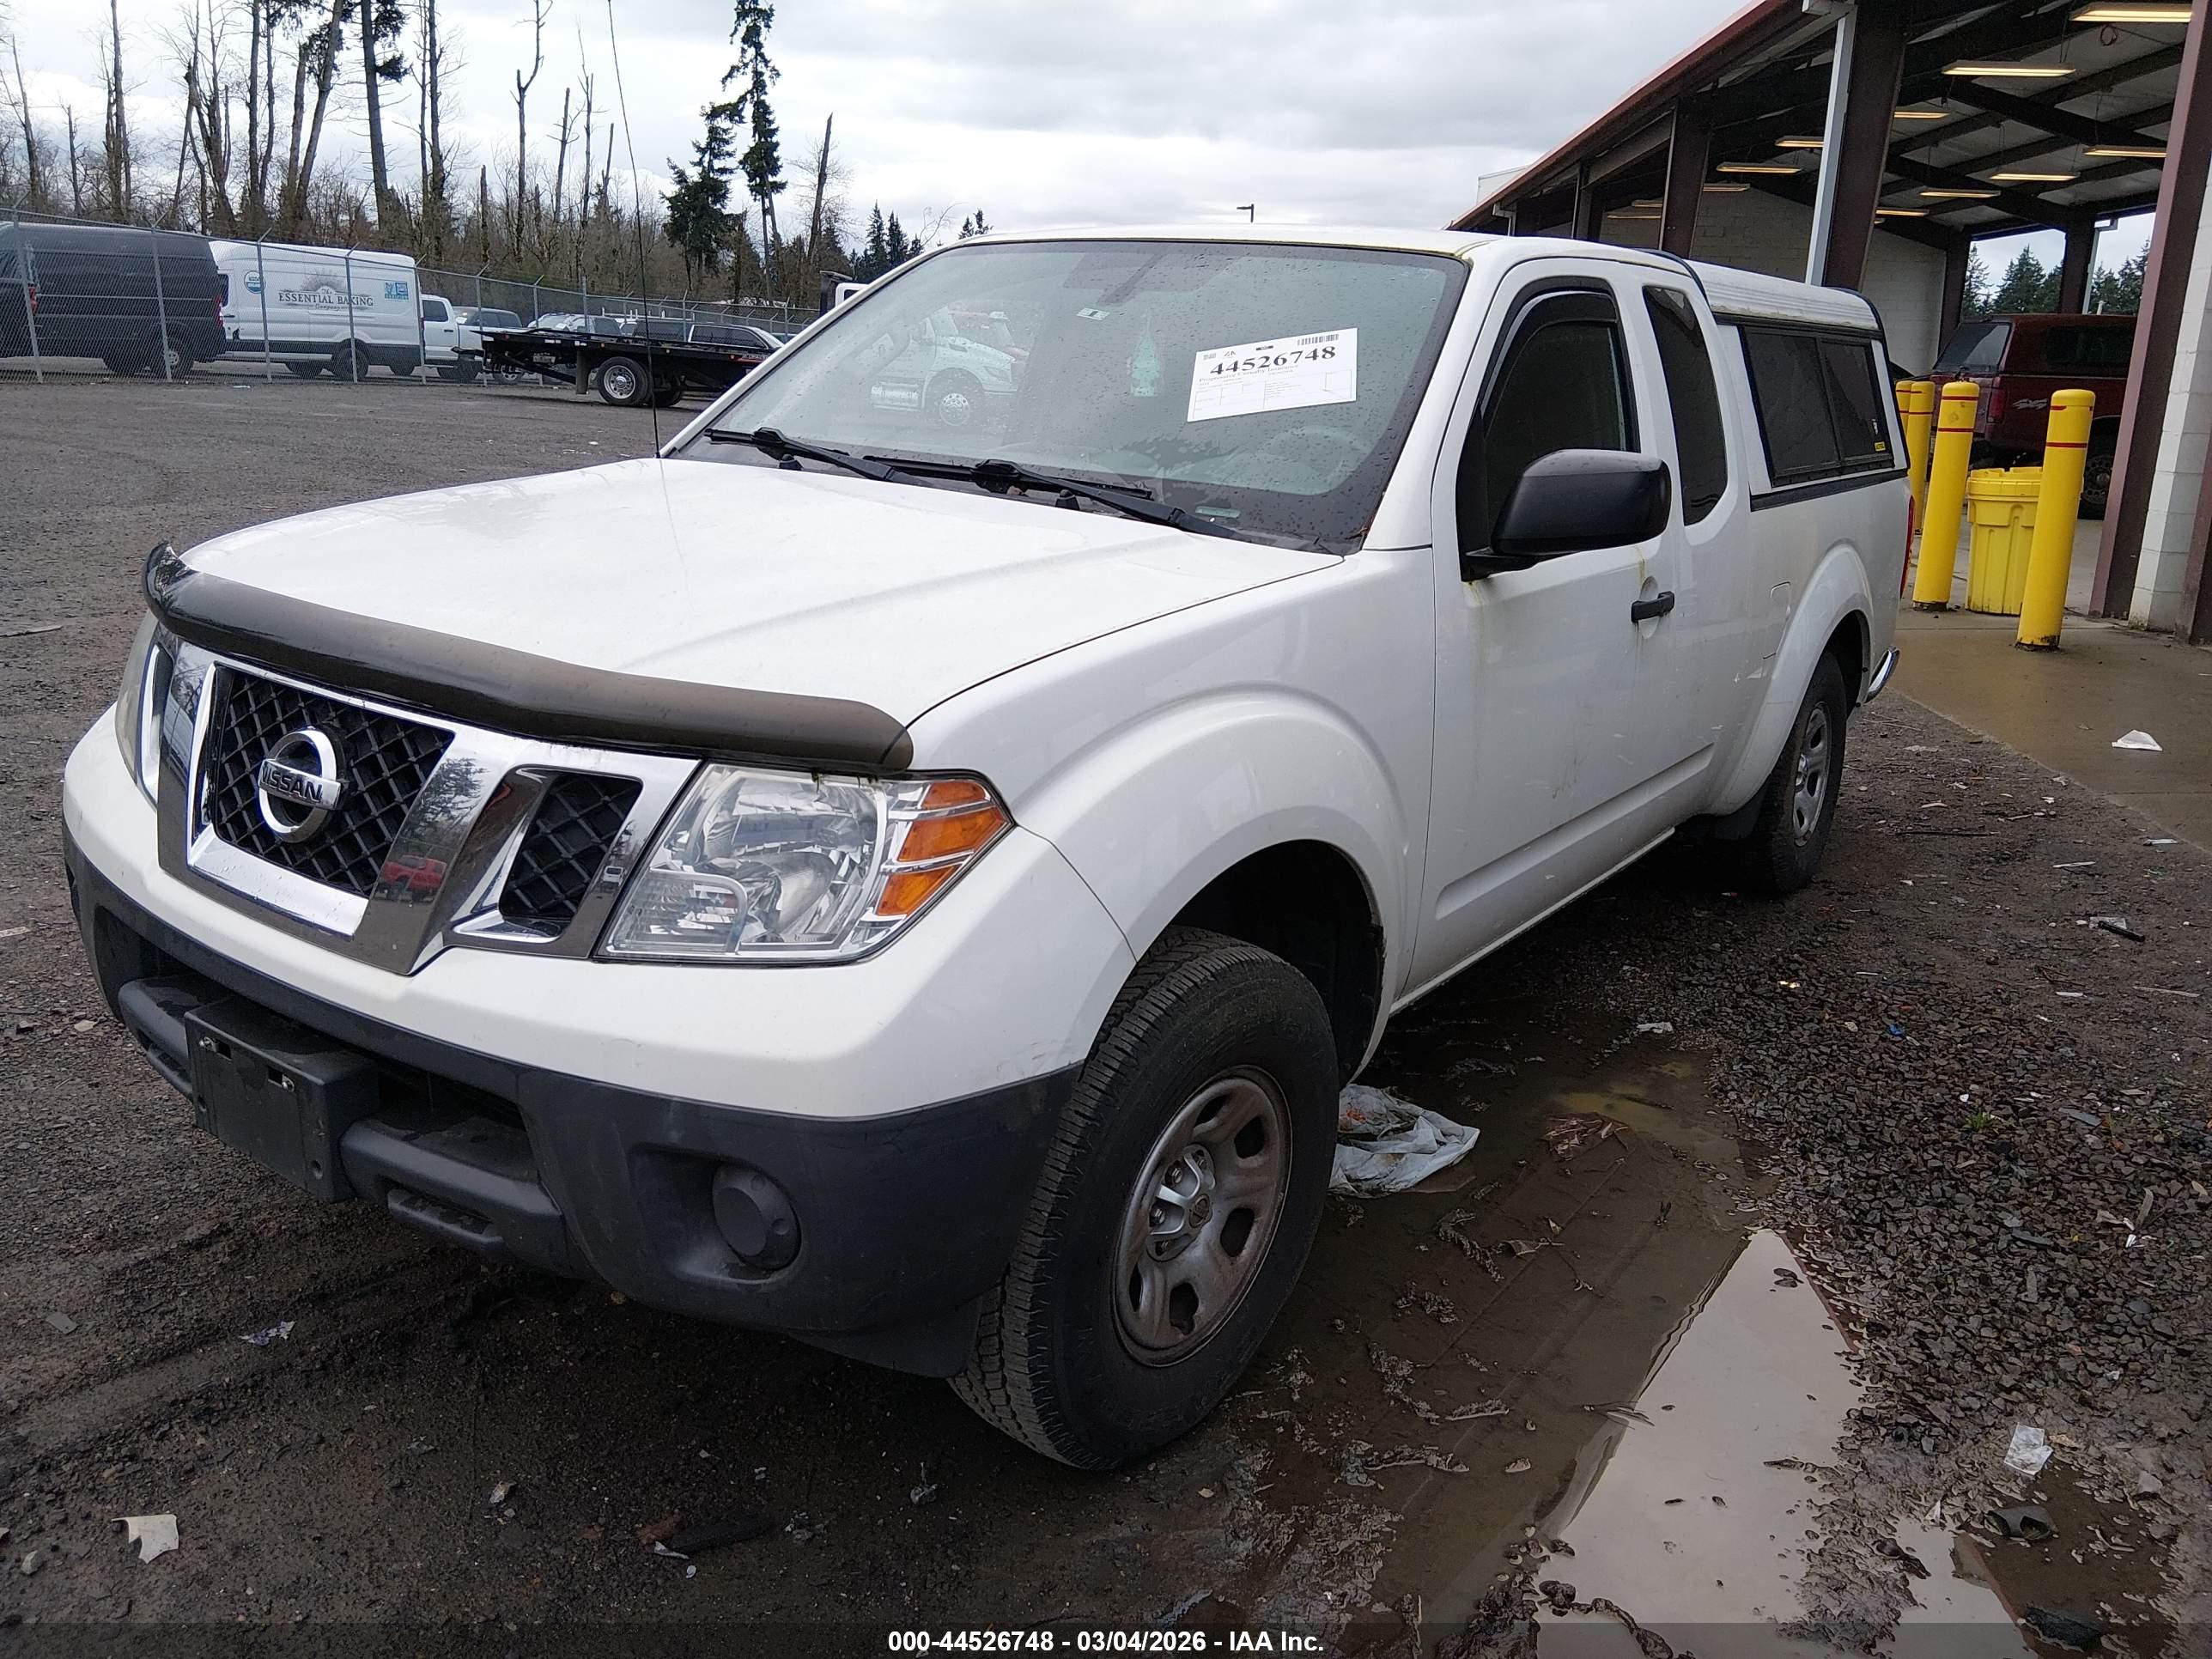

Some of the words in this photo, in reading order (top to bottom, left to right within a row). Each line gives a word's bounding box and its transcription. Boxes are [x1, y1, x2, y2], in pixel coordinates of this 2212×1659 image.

[279, 293, 333, 304] ESSENTIAL
[337, 295, 374, 307] BAKING
[1210, 346, 1337, 375] 44526748
[261, 762, 323, 803] NISSAN
